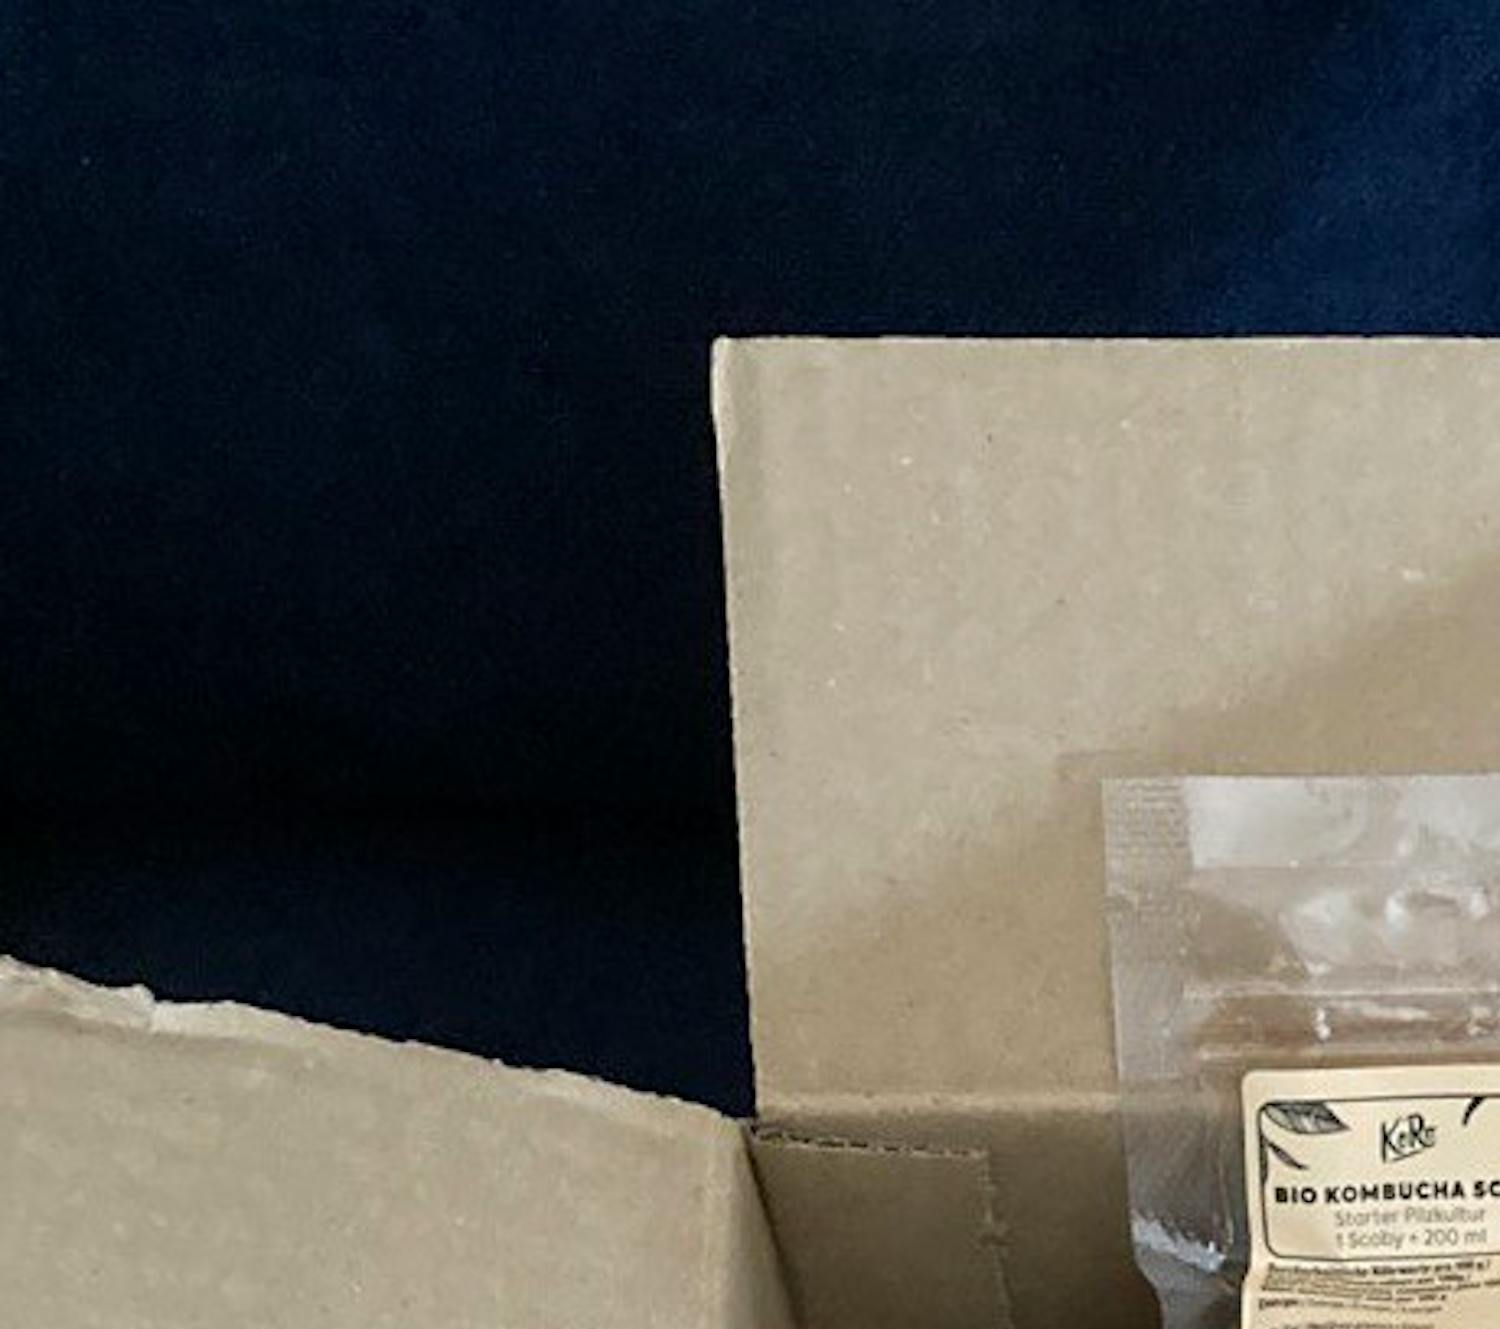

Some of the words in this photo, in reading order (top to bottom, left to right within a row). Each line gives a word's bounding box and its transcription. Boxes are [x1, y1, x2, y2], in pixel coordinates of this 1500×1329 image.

[1275, 1186, 1318, 1204] BIO
[1324, 1181, 1467, 1204] KOMBUCHA
[1335, 1209, 1399, 1227] Starter
[1405, 1204, 1486, 1224] Pilzkultur
[1336, 1231, 1343, 1246] 1
[1350, 1229, 1401, 1249] Scoby
[1424, 1227, 1461, 1245] 200
[1464, 1228, 1488, 1245] ml
